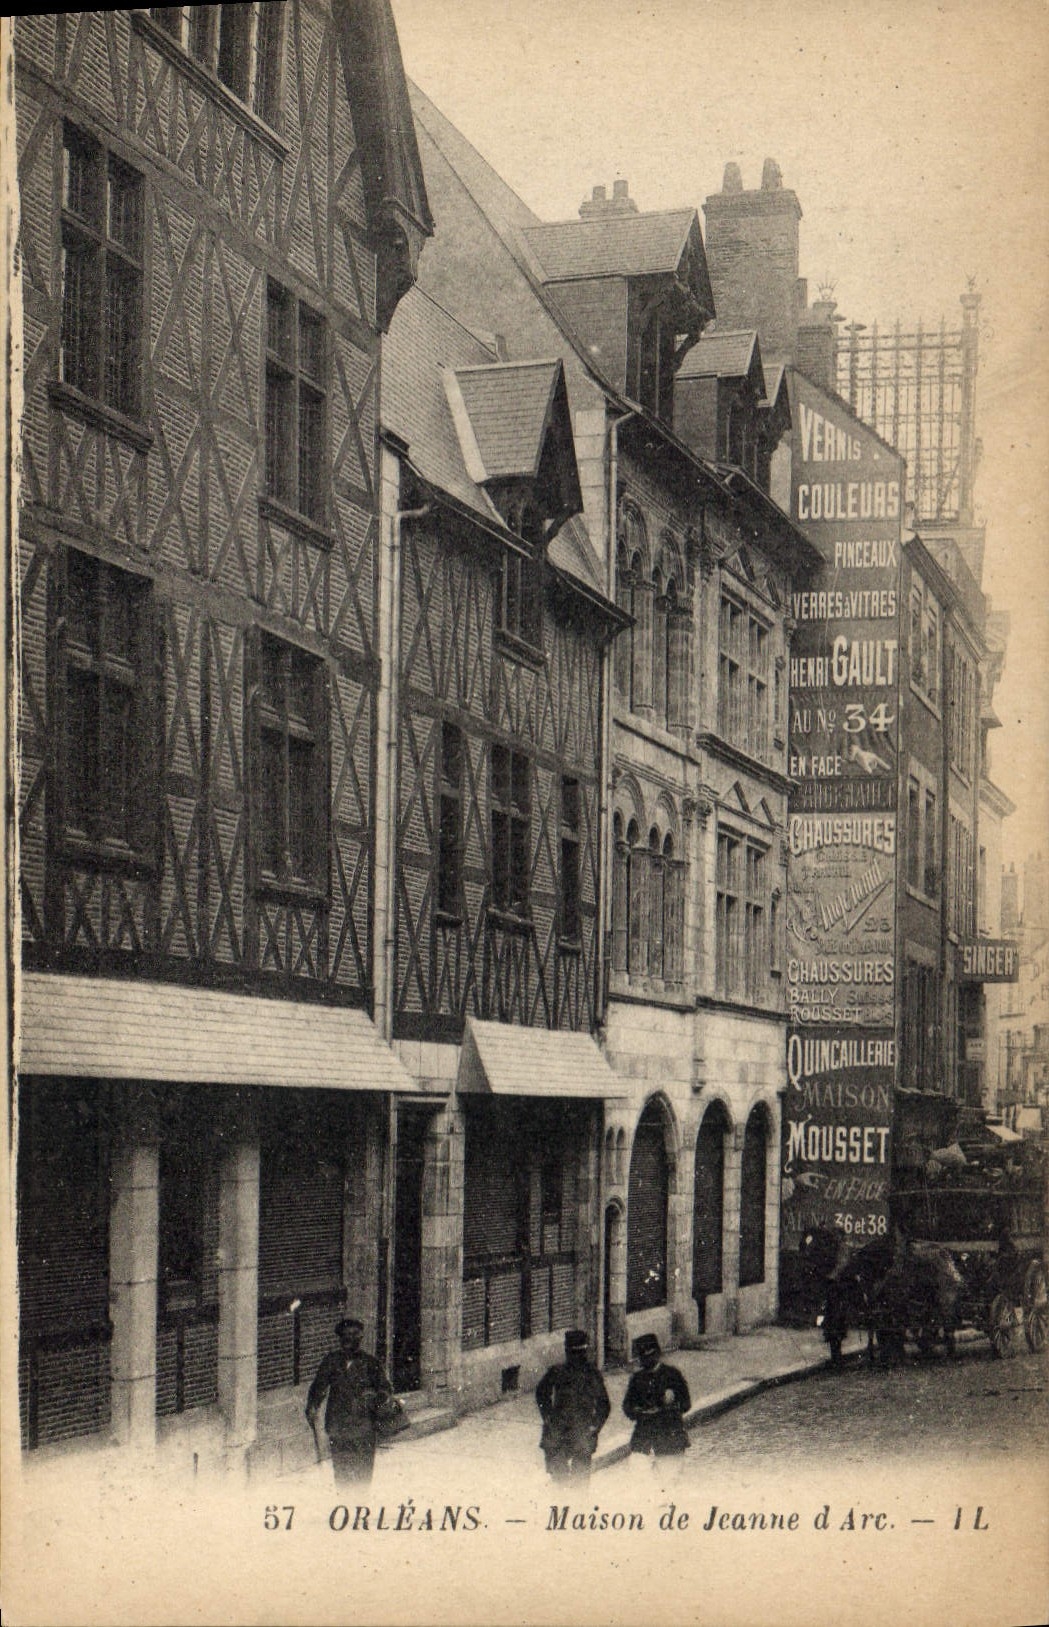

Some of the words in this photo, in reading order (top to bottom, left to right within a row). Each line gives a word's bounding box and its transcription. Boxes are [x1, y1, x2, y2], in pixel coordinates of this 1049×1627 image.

[799, 403, 862, 462] VERNIS
[798, 481, 899, 519] COULEURS
[834, 540, 898, 568] PINCEAUX
[793, 591, 843, 620] VERRES
[850, 590, 897, 619] VITRES
[790, 656, 829, 687] HENRI
[831, 634, 899, 688] GAULT
[791, 709, 812, 733] AU
[841, 702, 896, 733] 34
[789, 755, 806, 777] EN
[811, 755, 842, 777] FACE
[788, 815, 896, 855] CHAUSSURES
[787, 958, 895, 984] CHAUSSURES
[962, 945, 1014, 977] SINGER
[788, 987, 839, 1005] BALLY
[789, 1004, 863, 1025] ROUSSET
[787, 1034, 895, 1090] QUINCAILLERIE
[794, 1081, 891, 1112] MAISON
[783, 1113, 891, 1174] MOUSSET
[833, 1212, 853, 1234] 36
[854, 1217, 866, 1235] et
[866, 1213, 887, 1236] 38
